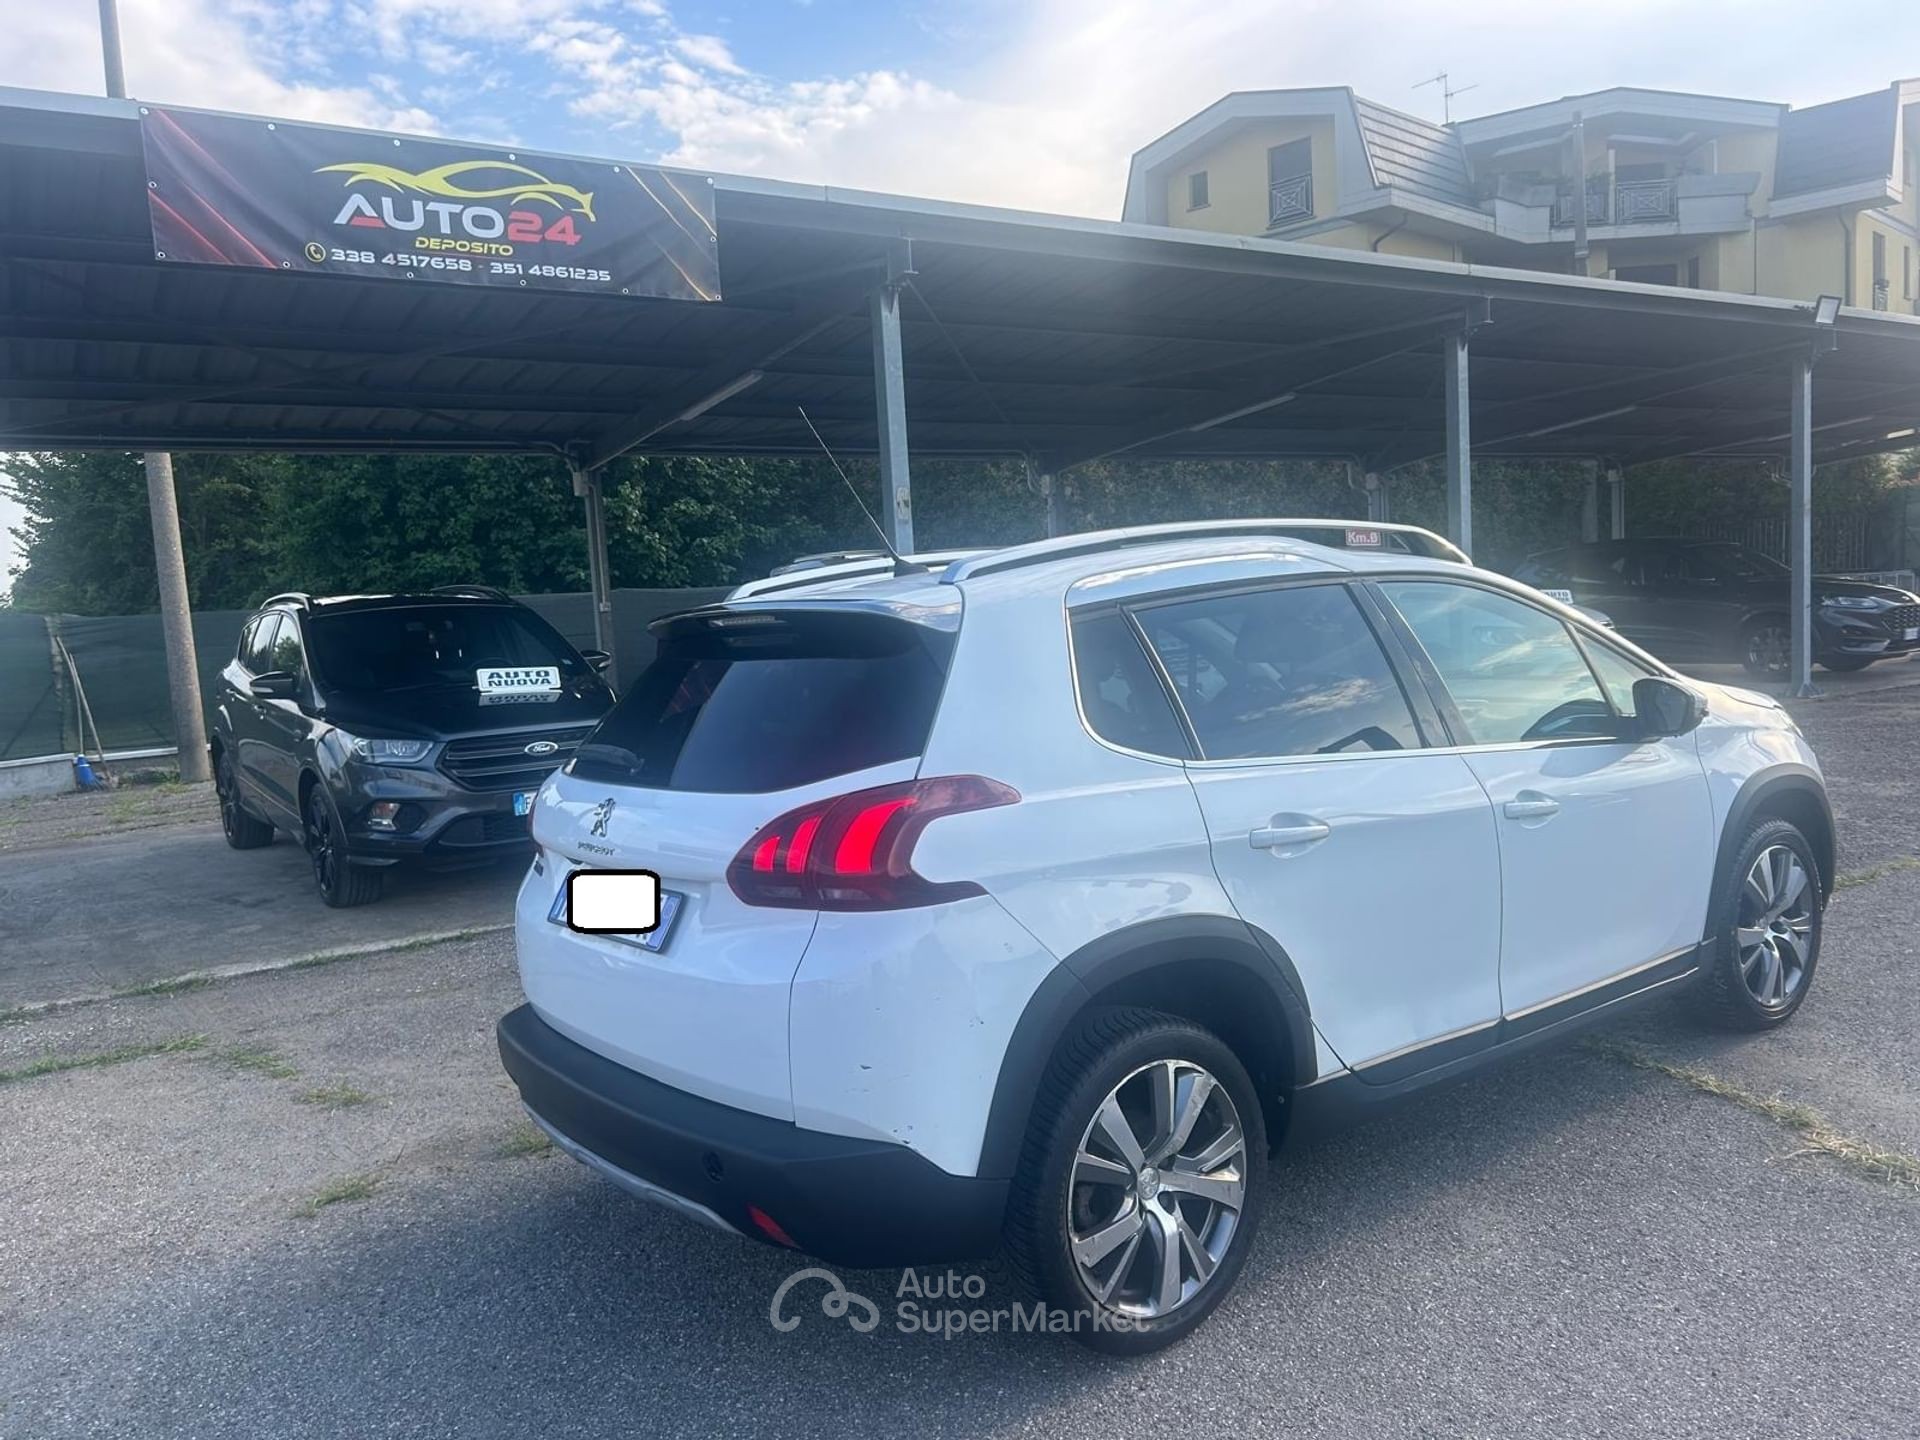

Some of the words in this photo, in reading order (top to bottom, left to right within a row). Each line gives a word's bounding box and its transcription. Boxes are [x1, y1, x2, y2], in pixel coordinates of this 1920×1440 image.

[333, 193, 582, 245] AUTO24
[415, 237, 513, 256] DEPOSITO
[331, 248, 375, 263] 338
[381, 253, 472, 271] 4517658
[490, 261, 523, 275] 351
[528, 264, 611, 281] 4861235
[487, 670, 550, 680] AUTO
[488, 678, 551, 687] NUOVA
